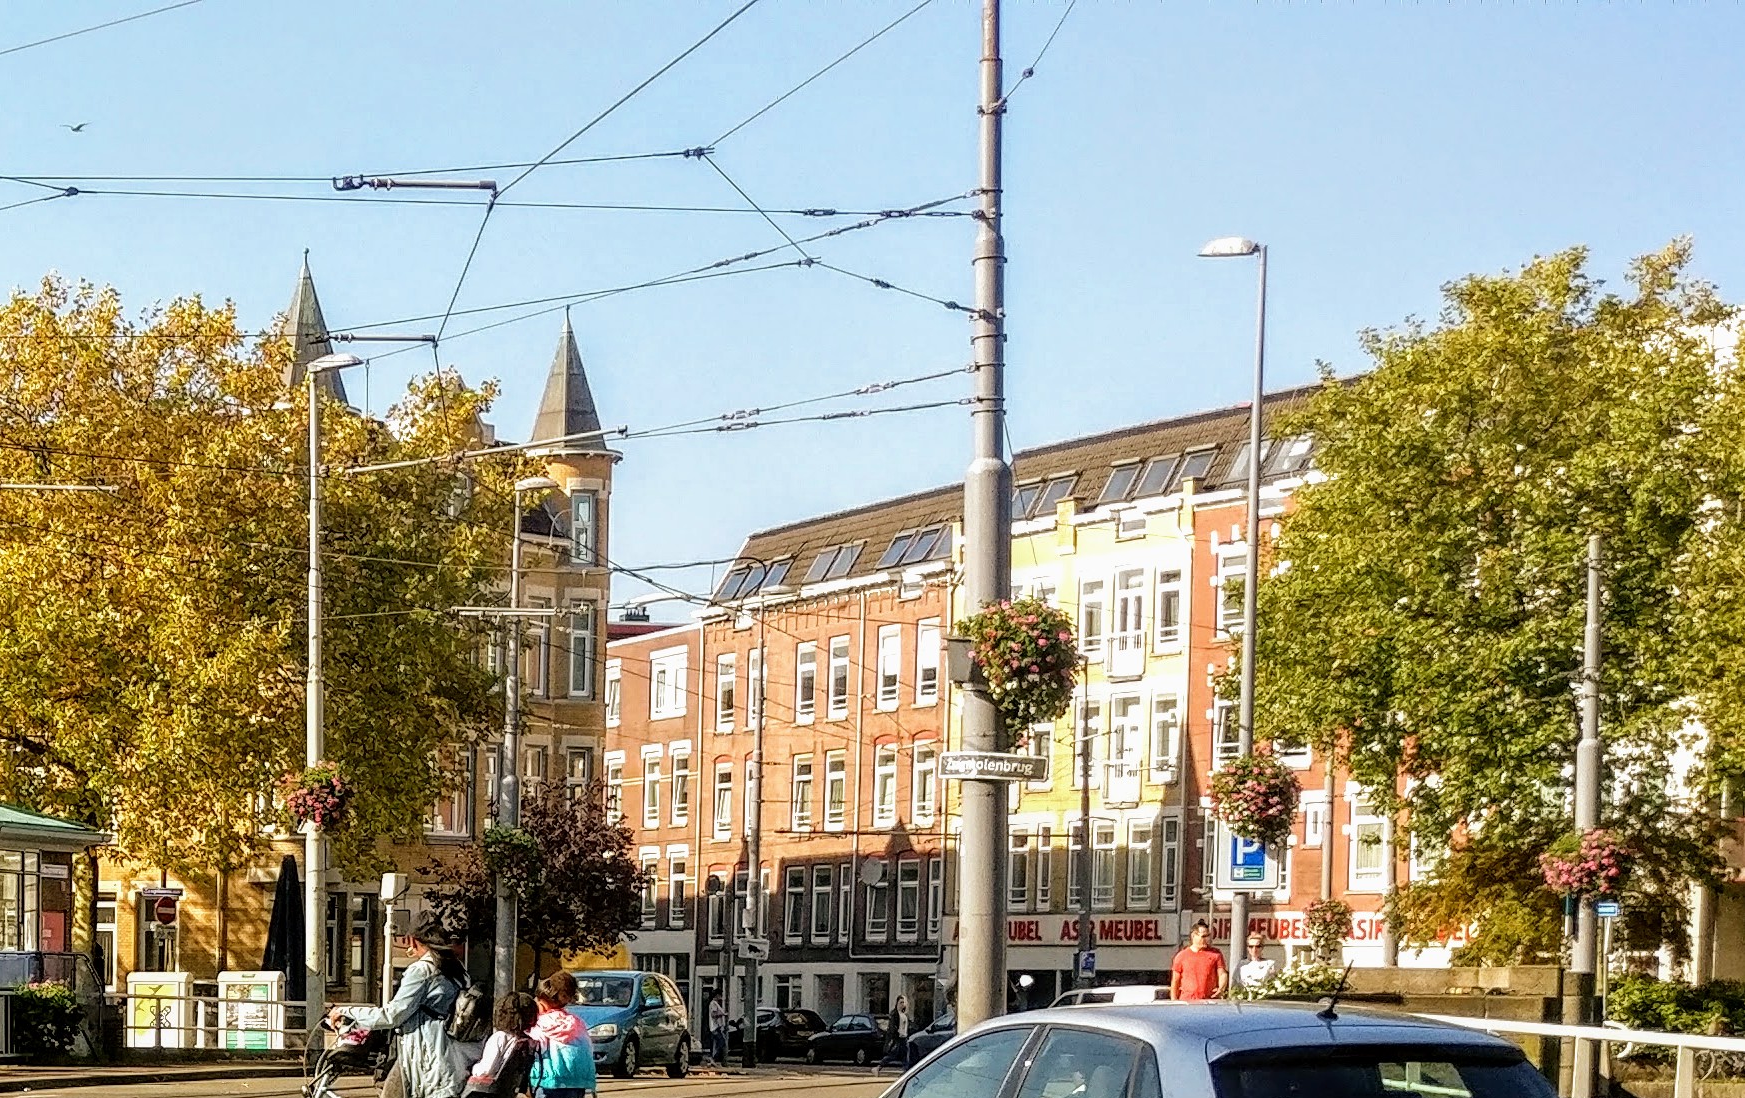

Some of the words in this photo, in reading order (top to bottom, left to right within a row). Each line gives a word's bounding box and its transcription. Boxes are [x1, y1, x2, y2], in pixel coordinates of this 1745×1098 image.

[1008, 920, 1042, 941] UBEL
[1060, 920, 1095, 941] AS
[1099, 919, 1162, 941] MEUBEL
